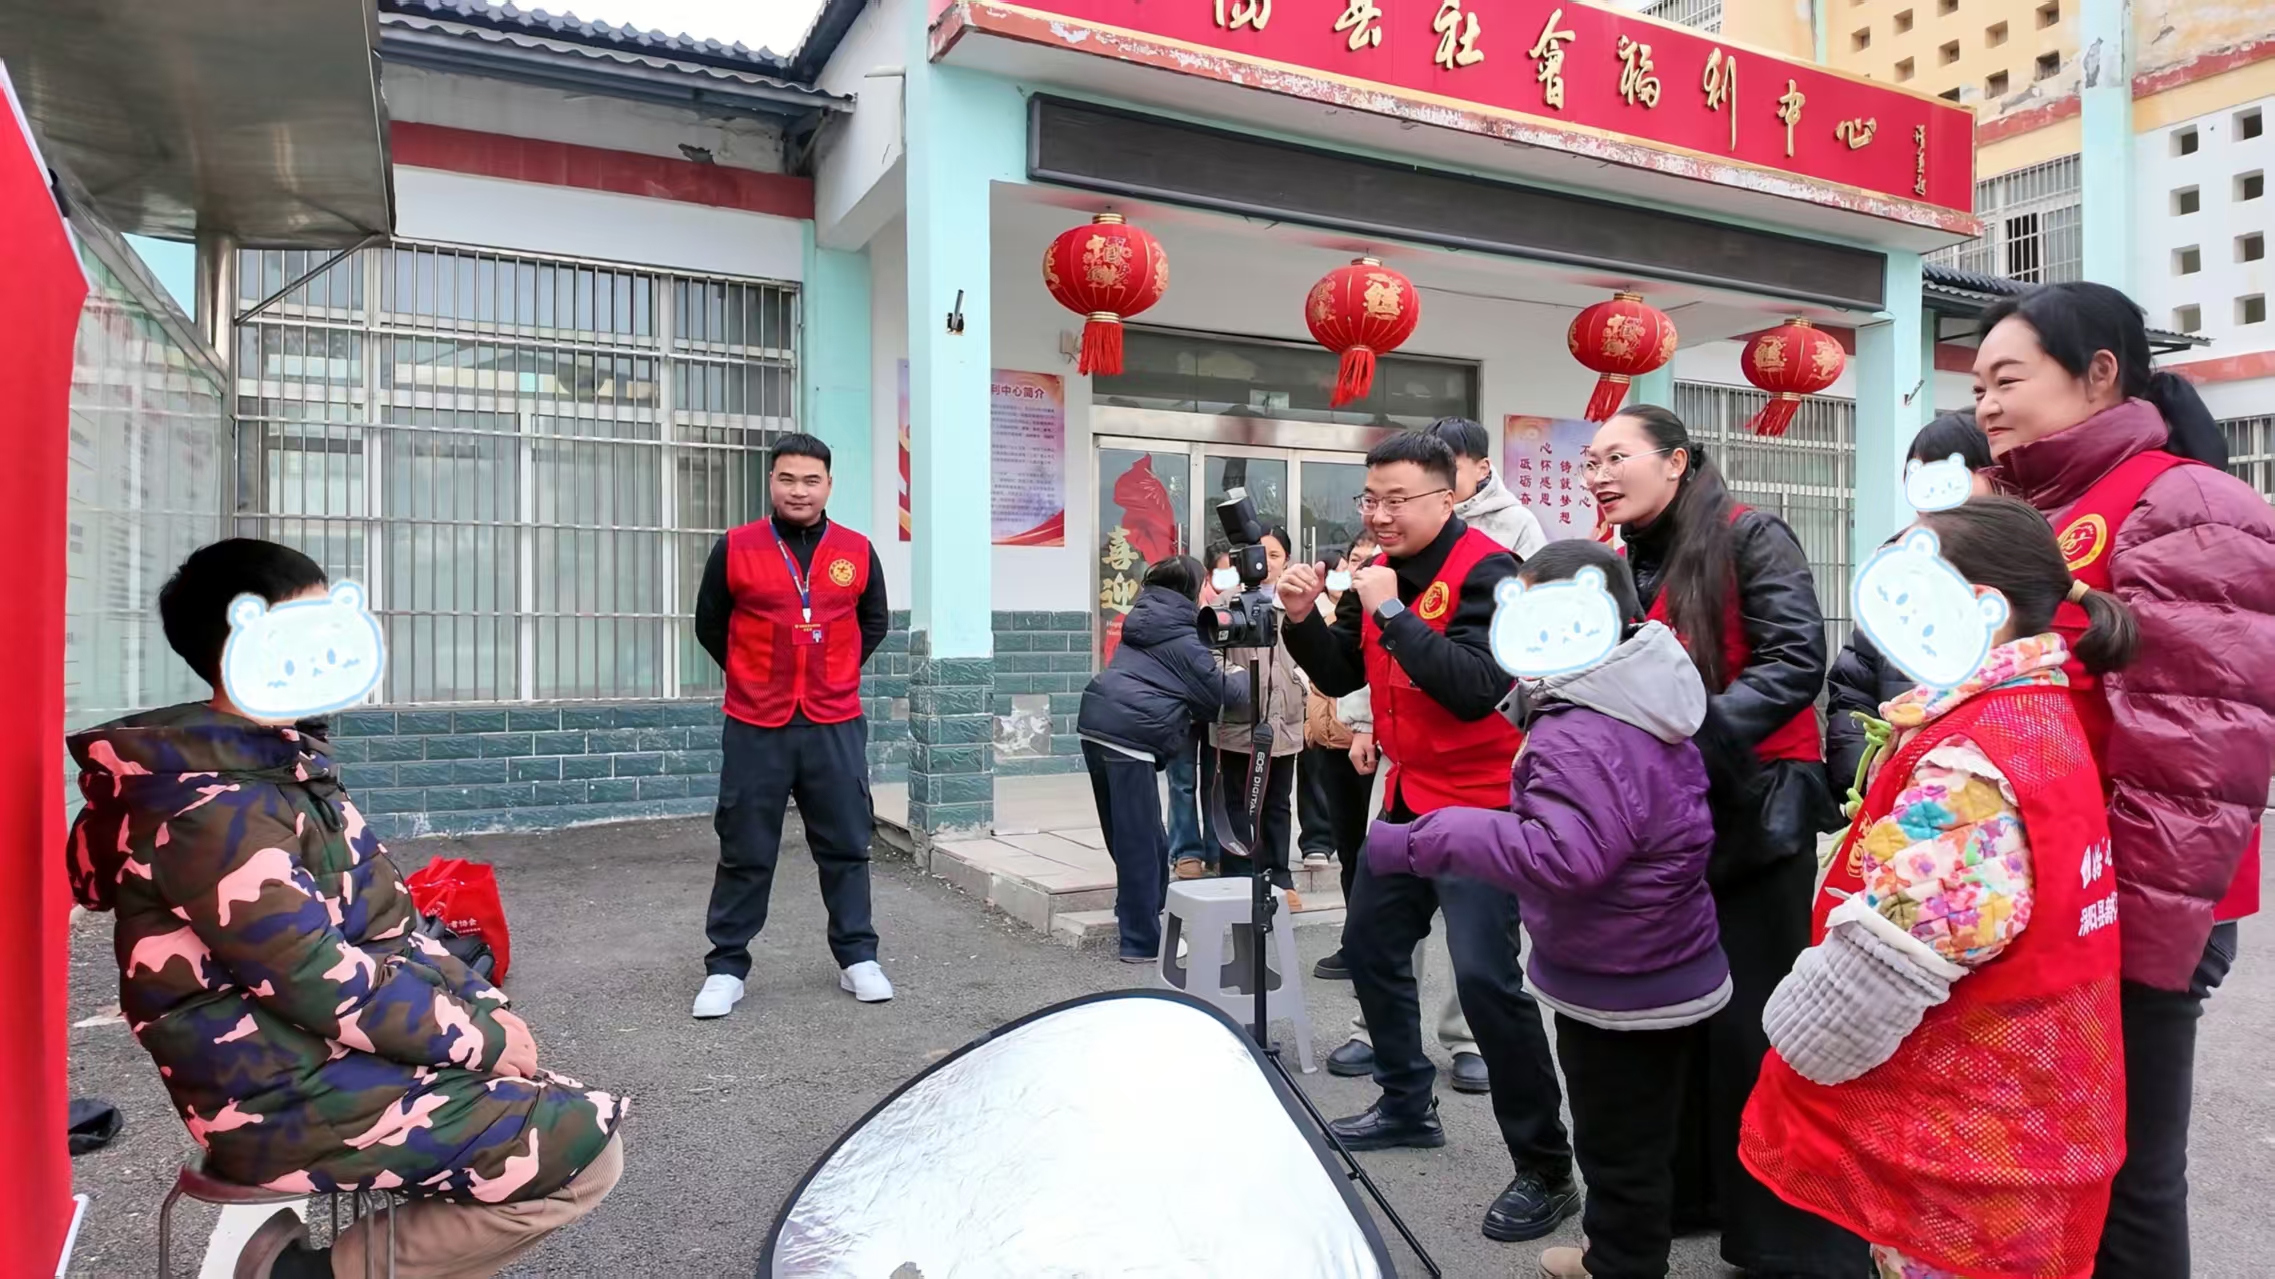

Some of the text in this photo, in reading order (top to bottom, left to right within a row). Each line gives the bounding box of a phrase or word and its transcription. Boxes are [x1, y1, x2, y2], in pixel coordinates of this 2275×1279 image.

[1519, 458, 1532, 505] 砥砺奋
[1539, 442, 1552, 507] 心怀感恩
[1559, 460, 1572, 524] 铸就梦想
[1100, 524, 1140, 615] 喜迎
[1249, 751, 1266, 816] EOS DIGITAL
[447, 918, 477, 929] 者协会
